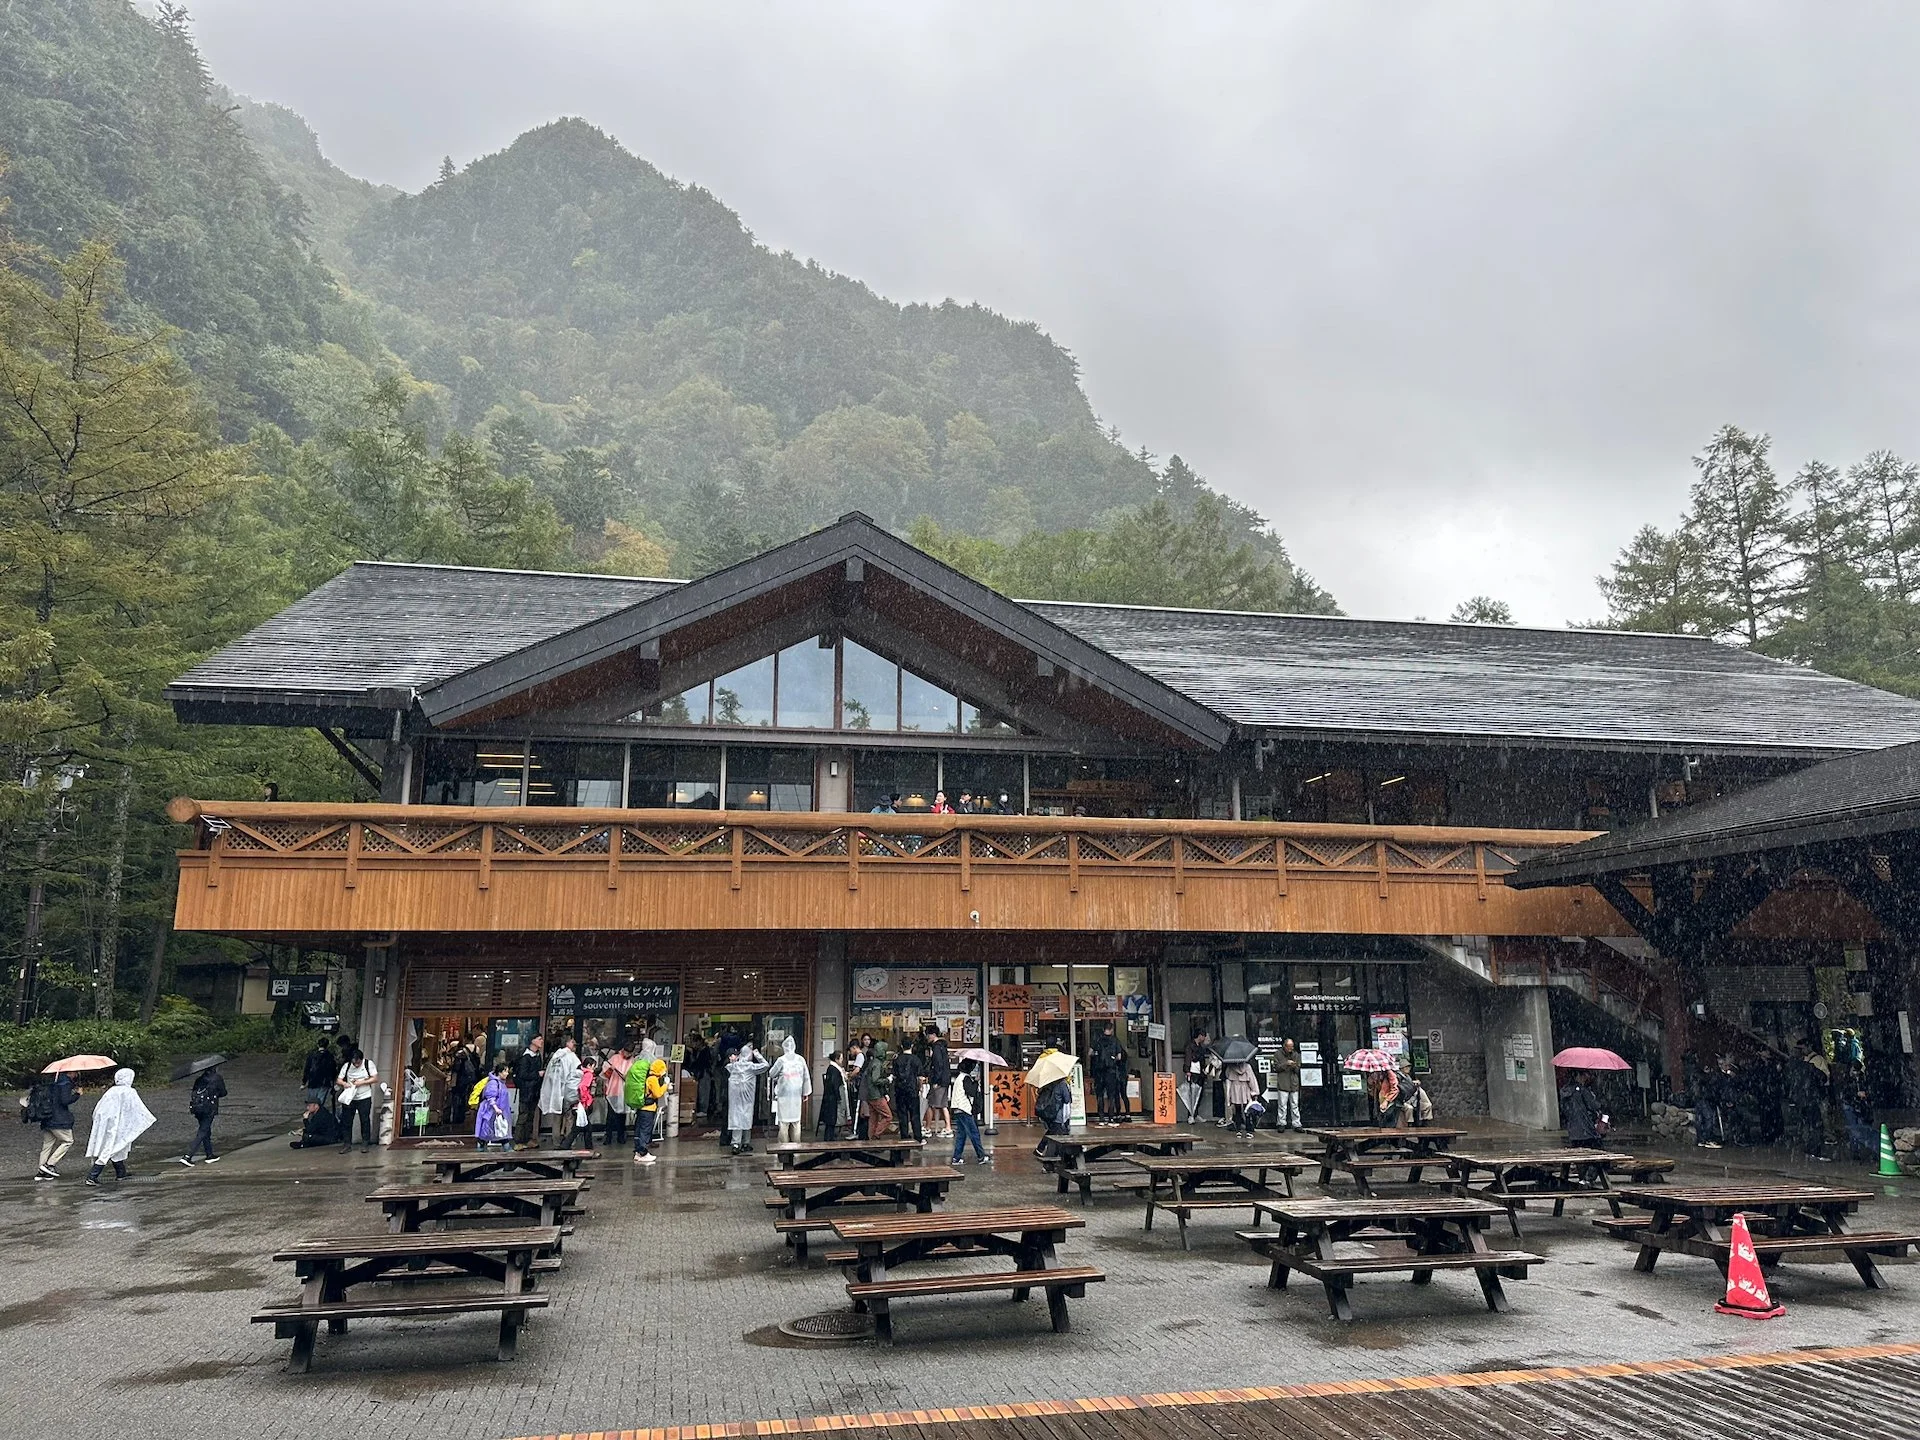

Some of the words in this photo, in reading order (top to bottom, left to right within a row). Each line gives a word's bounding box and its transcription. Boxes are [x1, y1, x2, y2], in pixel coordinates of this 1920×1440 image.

[584, 986, 630, 997] おみやげ処
[632, 985, 673, 996] ピッケル
[910, 977, 974, 995] 河童焼
[583, 1001, 621, 1010] souvenir
[623, 1000, 644, 1010] shop
[646, 999, 672, 1010] pickel
[1158, 1080, 1168, 1117] お弁当
